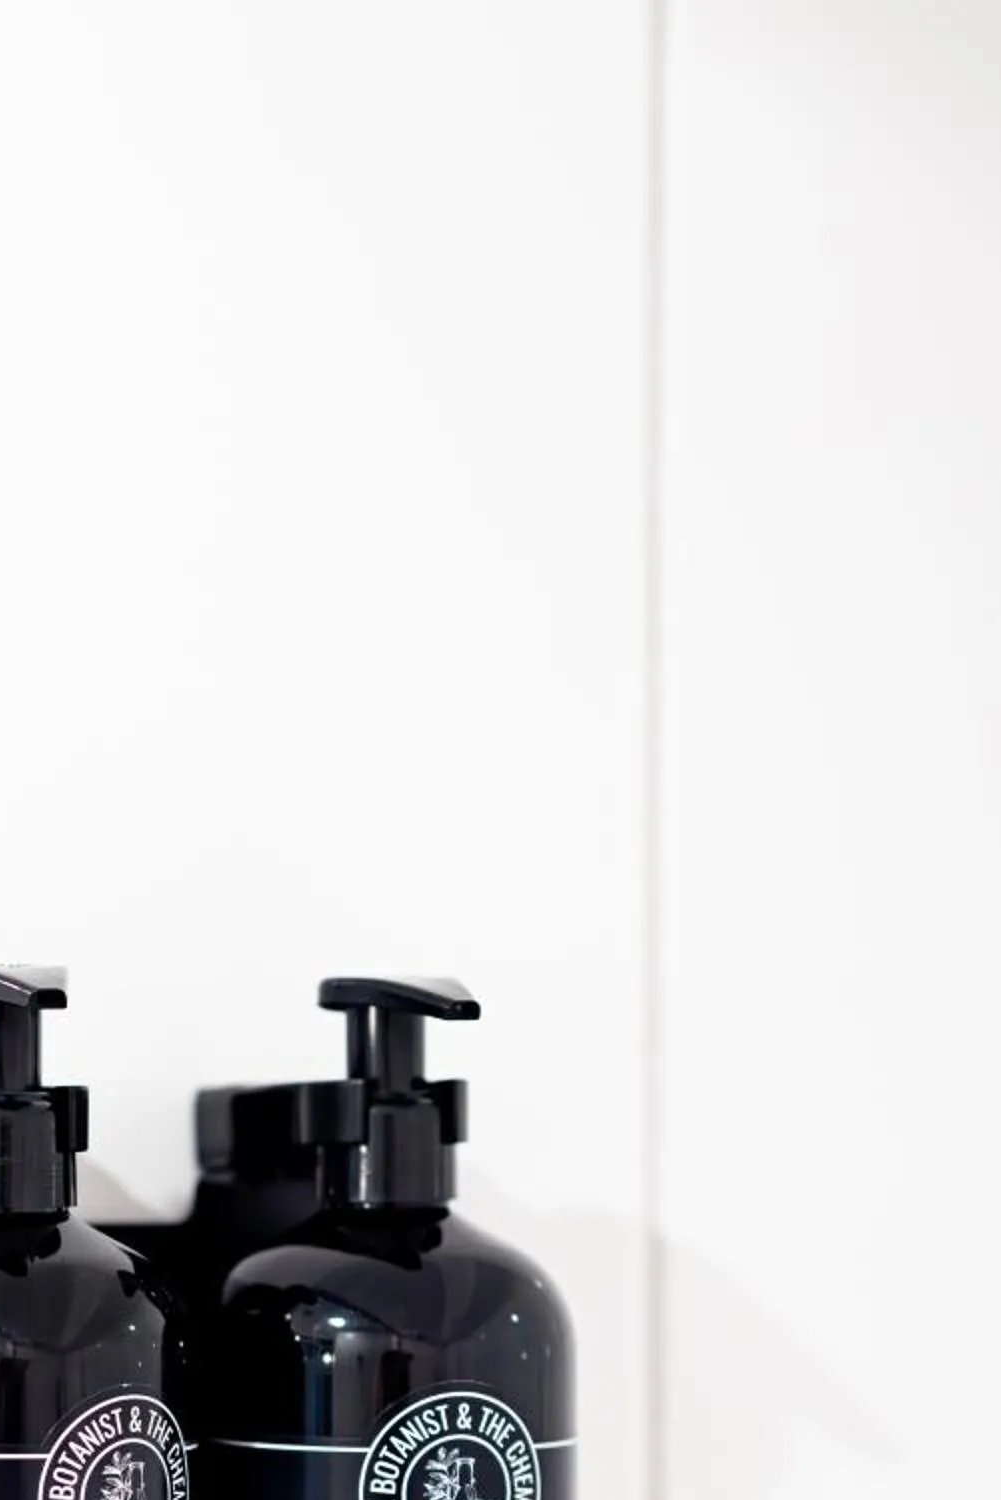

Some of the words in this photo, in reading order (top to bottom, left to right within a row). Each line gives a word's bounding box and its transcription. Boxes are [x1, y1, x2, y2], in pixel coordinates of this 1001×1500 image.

[129, 1406, 142, 1433] &
[147, 1409, 174, 1453] THE
[370, 1404, 450, 1495] BOTANIST
[456, 1403, 473, 1430] &
[479, 1407, 515, 1447] THE
